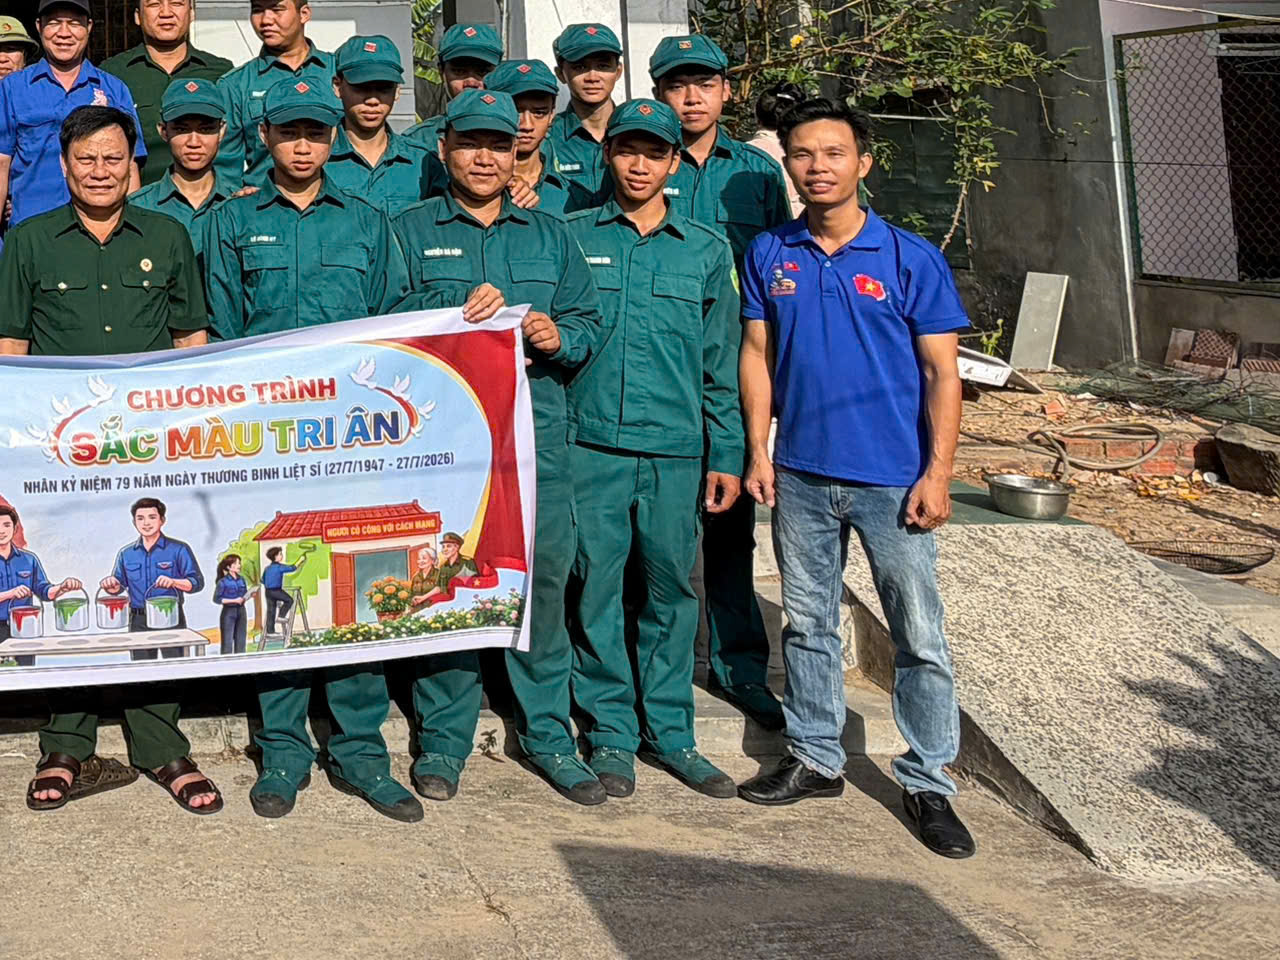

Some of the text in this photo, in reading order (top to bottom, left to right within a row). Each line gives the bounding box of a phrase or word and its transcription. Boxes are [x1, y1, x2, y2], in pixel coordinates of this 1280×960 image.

[126, 375, 337, 411] CHƯƠNG TRÌNH
[70, 404, 403, 466] SẮC MÀU TRI ÂN
[23, 478, 58, 494] NHÂN
[61, 474, 77, 492] KỶ
[80, 475, 113, 494] NIỆM
[115, 477, 131, 490] 79
[133, 473, 162, 489] NĂM
[165, 470, 197, 487] NGÀY
[200, 468, 248, 485] THƯƠNG
[251, 466, 280, 481] BINH
[283, 462, 307, 481] LIỆT
[324, 458, 385, 476] (27/7/1947
[396, 451, 455, 470] 27/7/2026)
